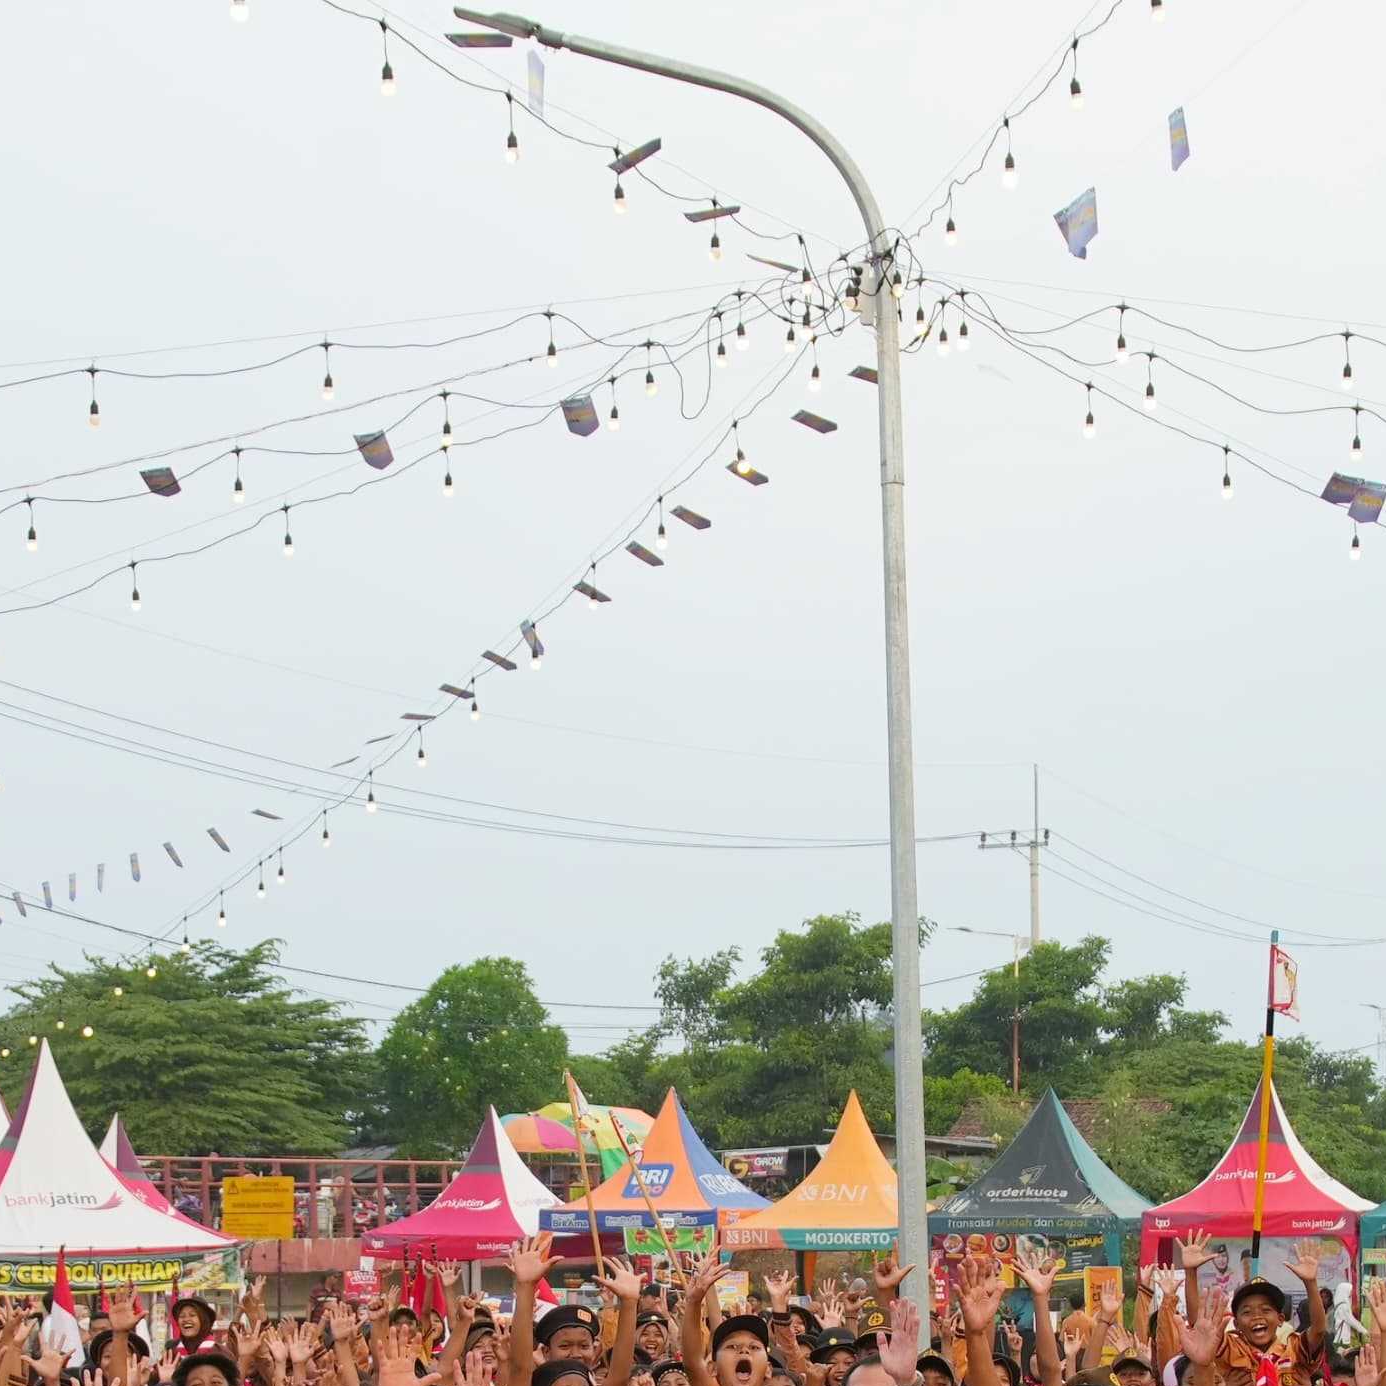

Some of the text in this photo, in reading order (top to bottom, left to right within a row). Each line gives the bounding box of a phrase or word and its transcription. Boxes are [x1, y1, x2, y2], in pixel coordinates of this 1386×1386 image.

[1215, 1167, 1277, 1182] bankjatm
[820, 1184, 869, 1201] BNI
[986, 1186, 1068, 1199] orderkuota
[5, 1192, 98, 1208] bankjatim
[948, 1218, 994, 1228] Transaksi
[1034, 1217, 1054, 1228] dan
[1292, 1218, 1334, 1230] bankjatim
[741, 1230, 769, 1243] BNI
[805, 1231, 890, 1245] MOJOKERTO
[102, 1260, 182, 1285] DURIAN
